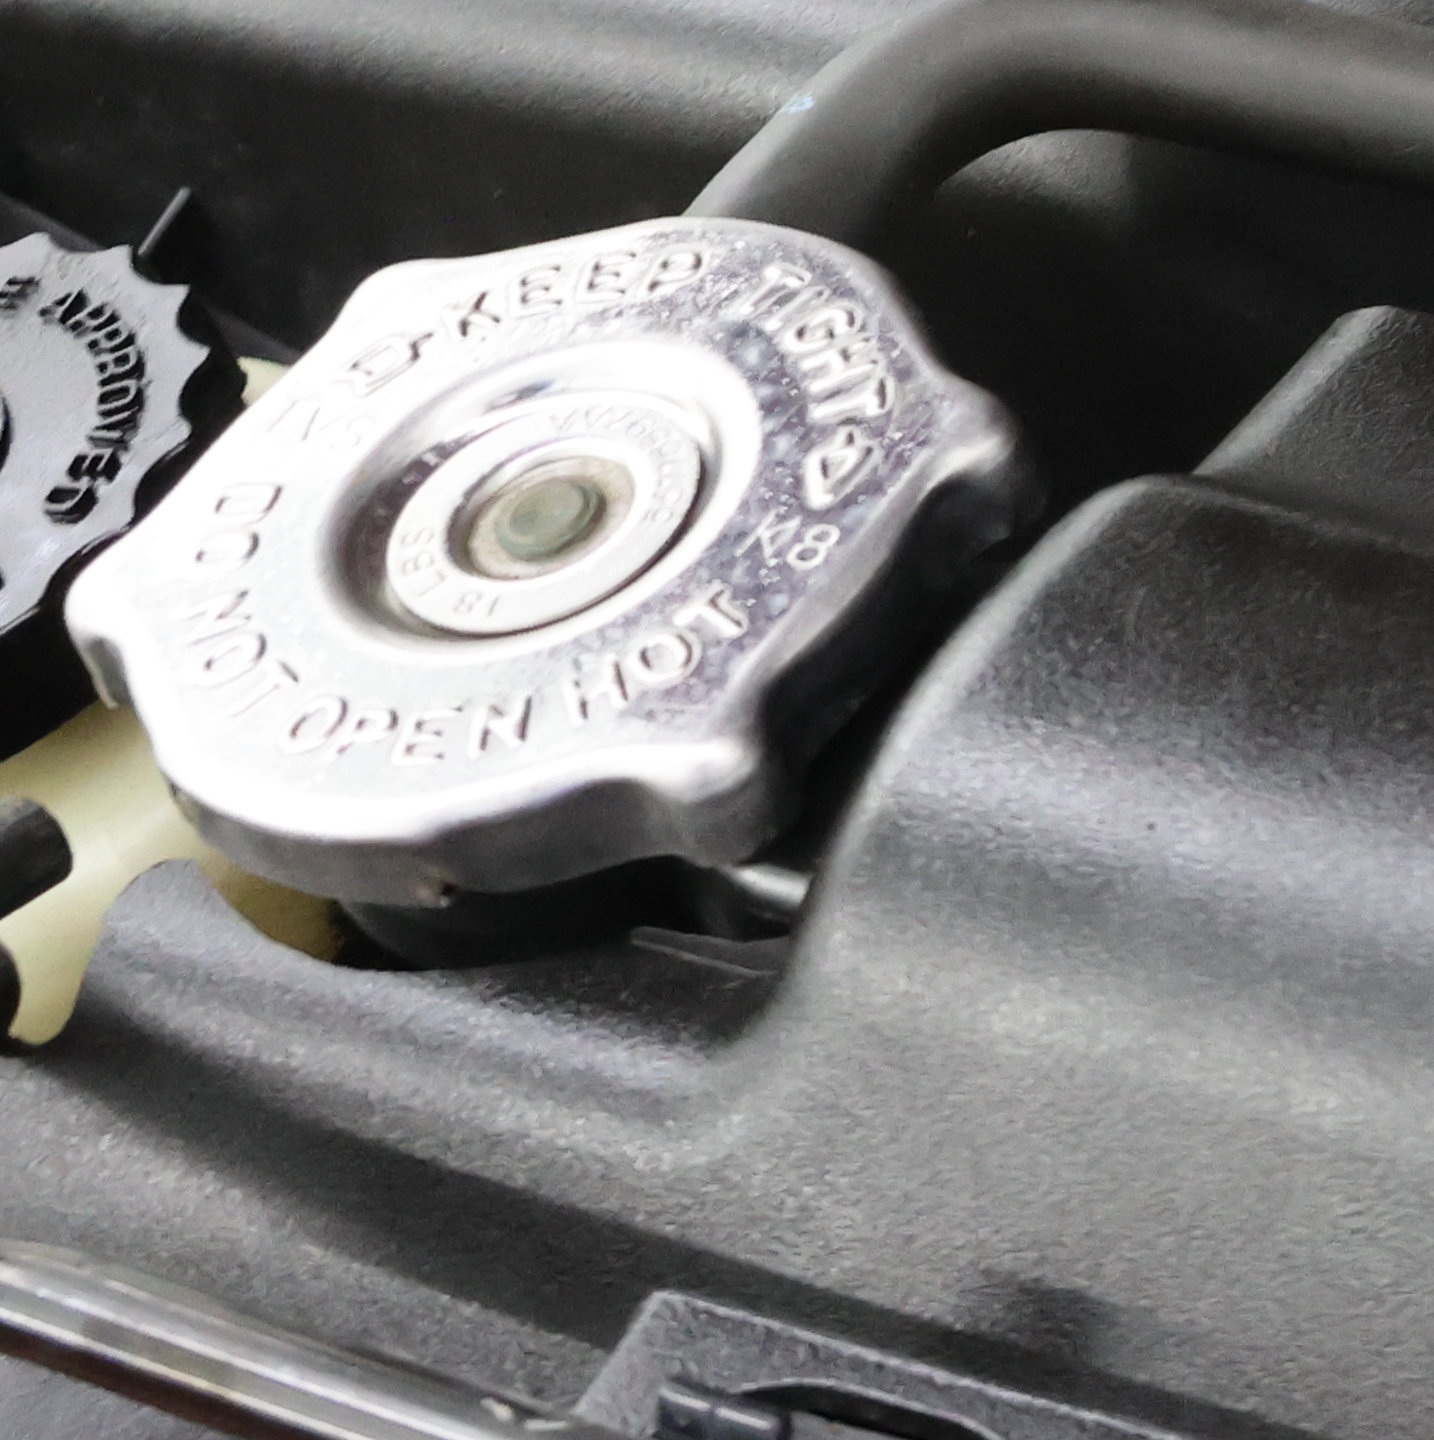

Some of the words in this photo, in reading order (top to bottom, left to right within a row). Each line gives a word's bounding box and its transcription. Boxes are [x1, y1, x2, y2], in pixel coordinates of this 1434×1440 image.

[38, 288, 148, 526] APPROVED
[182, 587, 301, 720] NOT
[277, 693, 535, 767] OPEN
[562, 581, 751, 724] HOT
